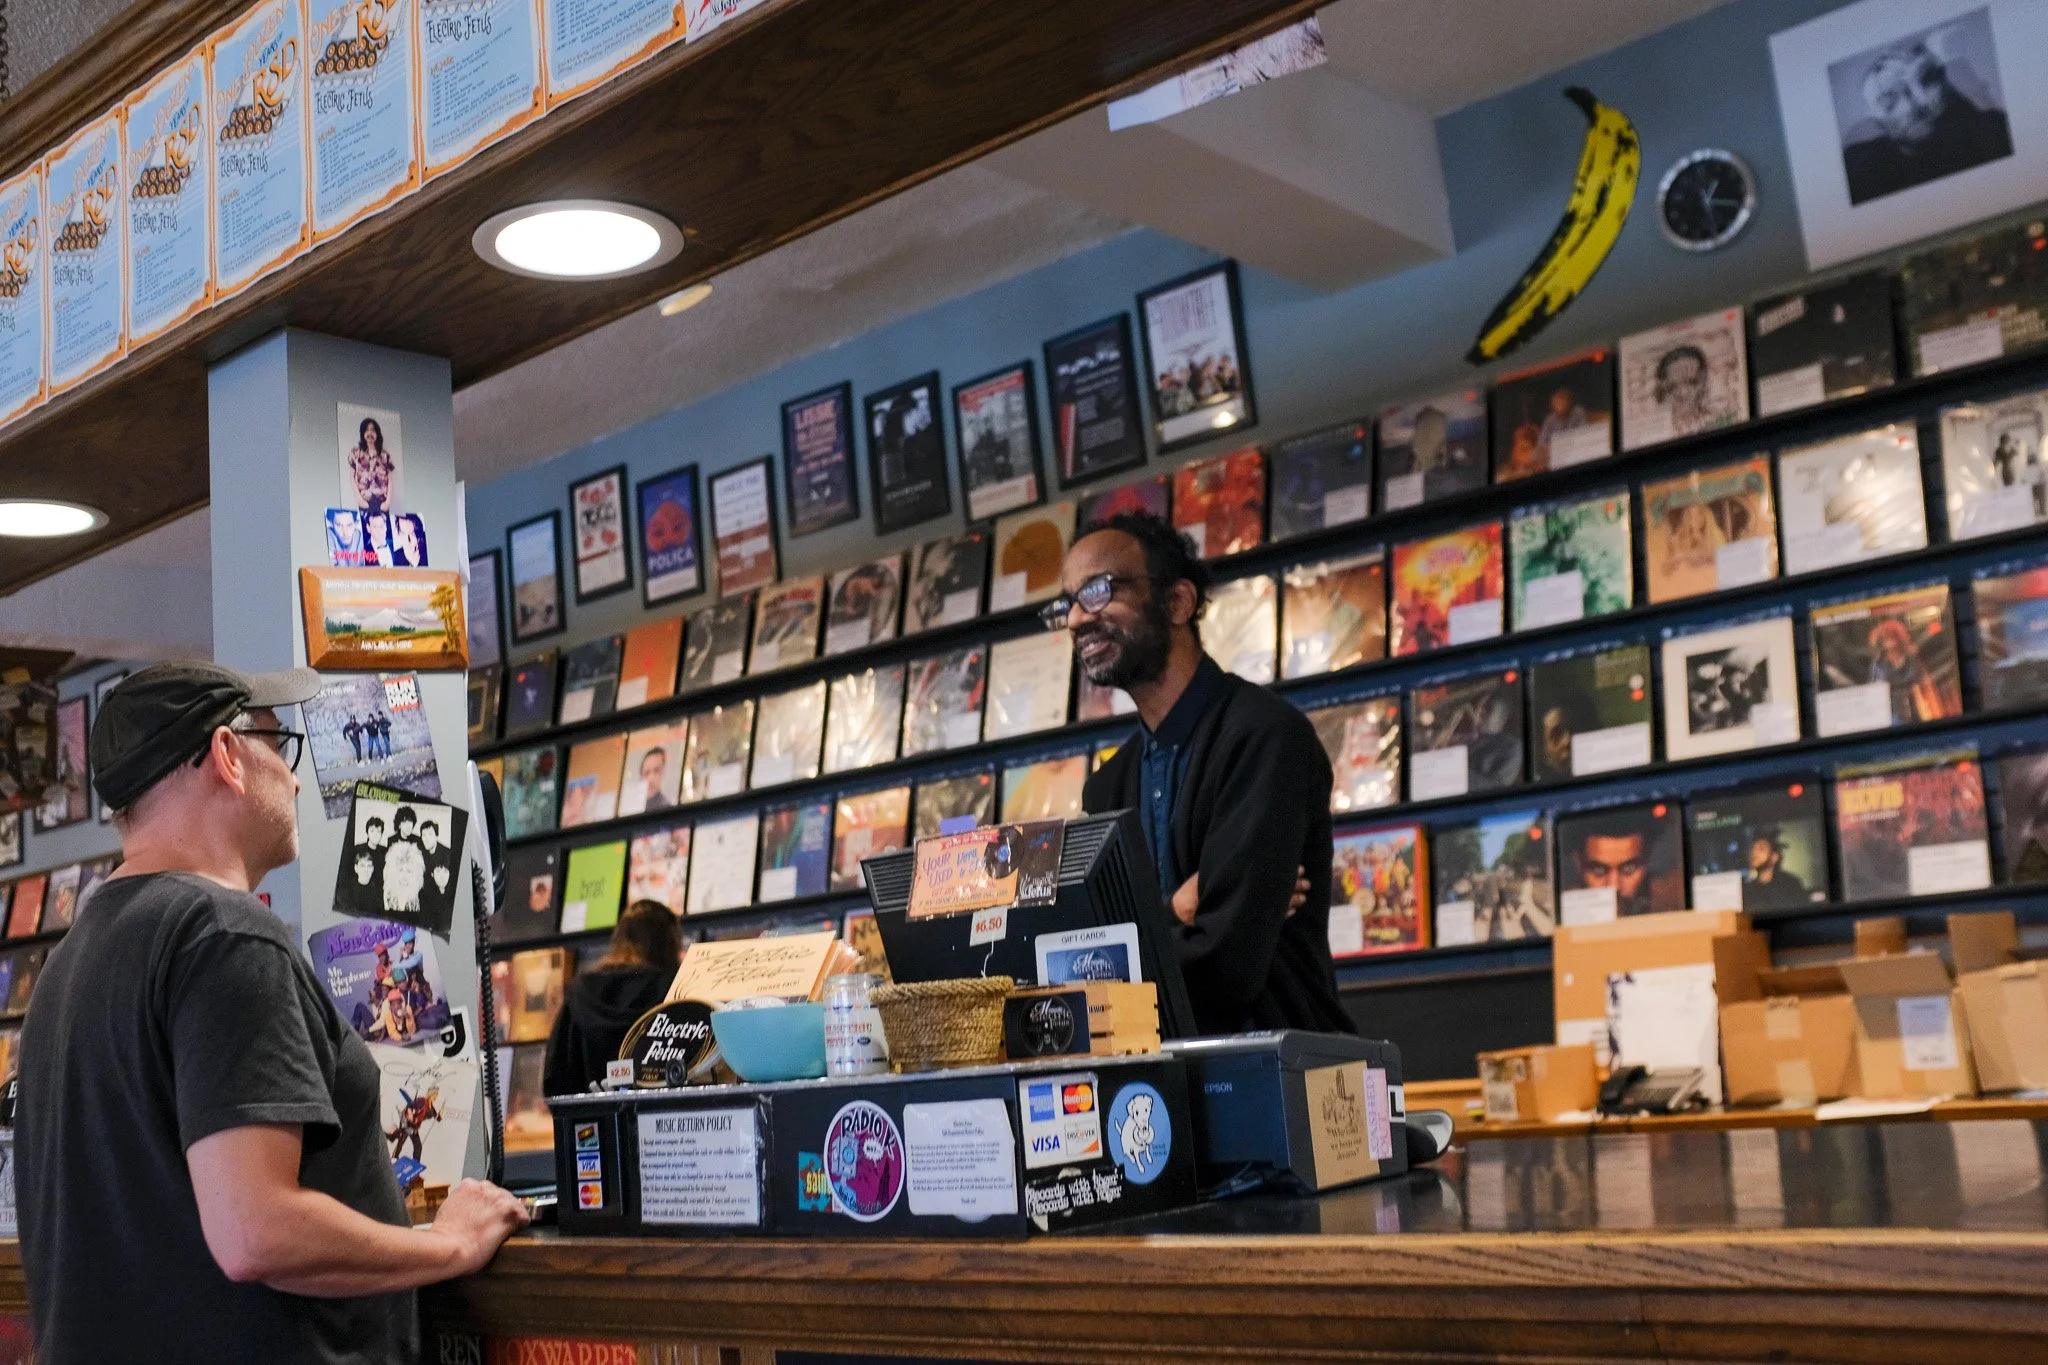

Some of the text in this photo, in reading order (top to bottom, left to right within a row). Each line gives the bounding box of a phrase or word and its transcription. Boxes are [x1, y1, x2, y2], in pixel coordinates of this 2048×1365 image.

[427, 12, 492, 43] ELECTRIC FETUS
[252, 36, 299, 117] RSD
[315, 87, 373, 114] ELECTRIC FETUS
[165, 101, 202, 176] RSD
[220, 151, 269, 177] ELECTRIC FETUS
[133, 210, 178, 235] ELECTRIC FETUS
[384, 679, 415, 697] RUN
[974, 916, 1003, 933] $6.50
[324, 929, 361, 965] New
[1061, 931, 1107, 944] GIFT CARDS
[646, 1013, 710, 1041] Electric
[641, 1038, 686, 1065] Fetus
[610, 1066, 631, 1078] $2.50
[1204, 1082, 1233, 1094] EPSON
[655, 1114, 733, 1134] MUSIC RETURN POLICY
[1066, 1128, 1096, 1140] DISCOVER
[840, 1108, 884, 1139] RADIO
[882, 1123, 897, 1161] K
[1032, 1135, 1061, 1153] VISA
[582, 1160, 597, 1171] VISA
[1068, 1177, 1092, 1196] with
[1072, 1191, 1095, 1208] with
